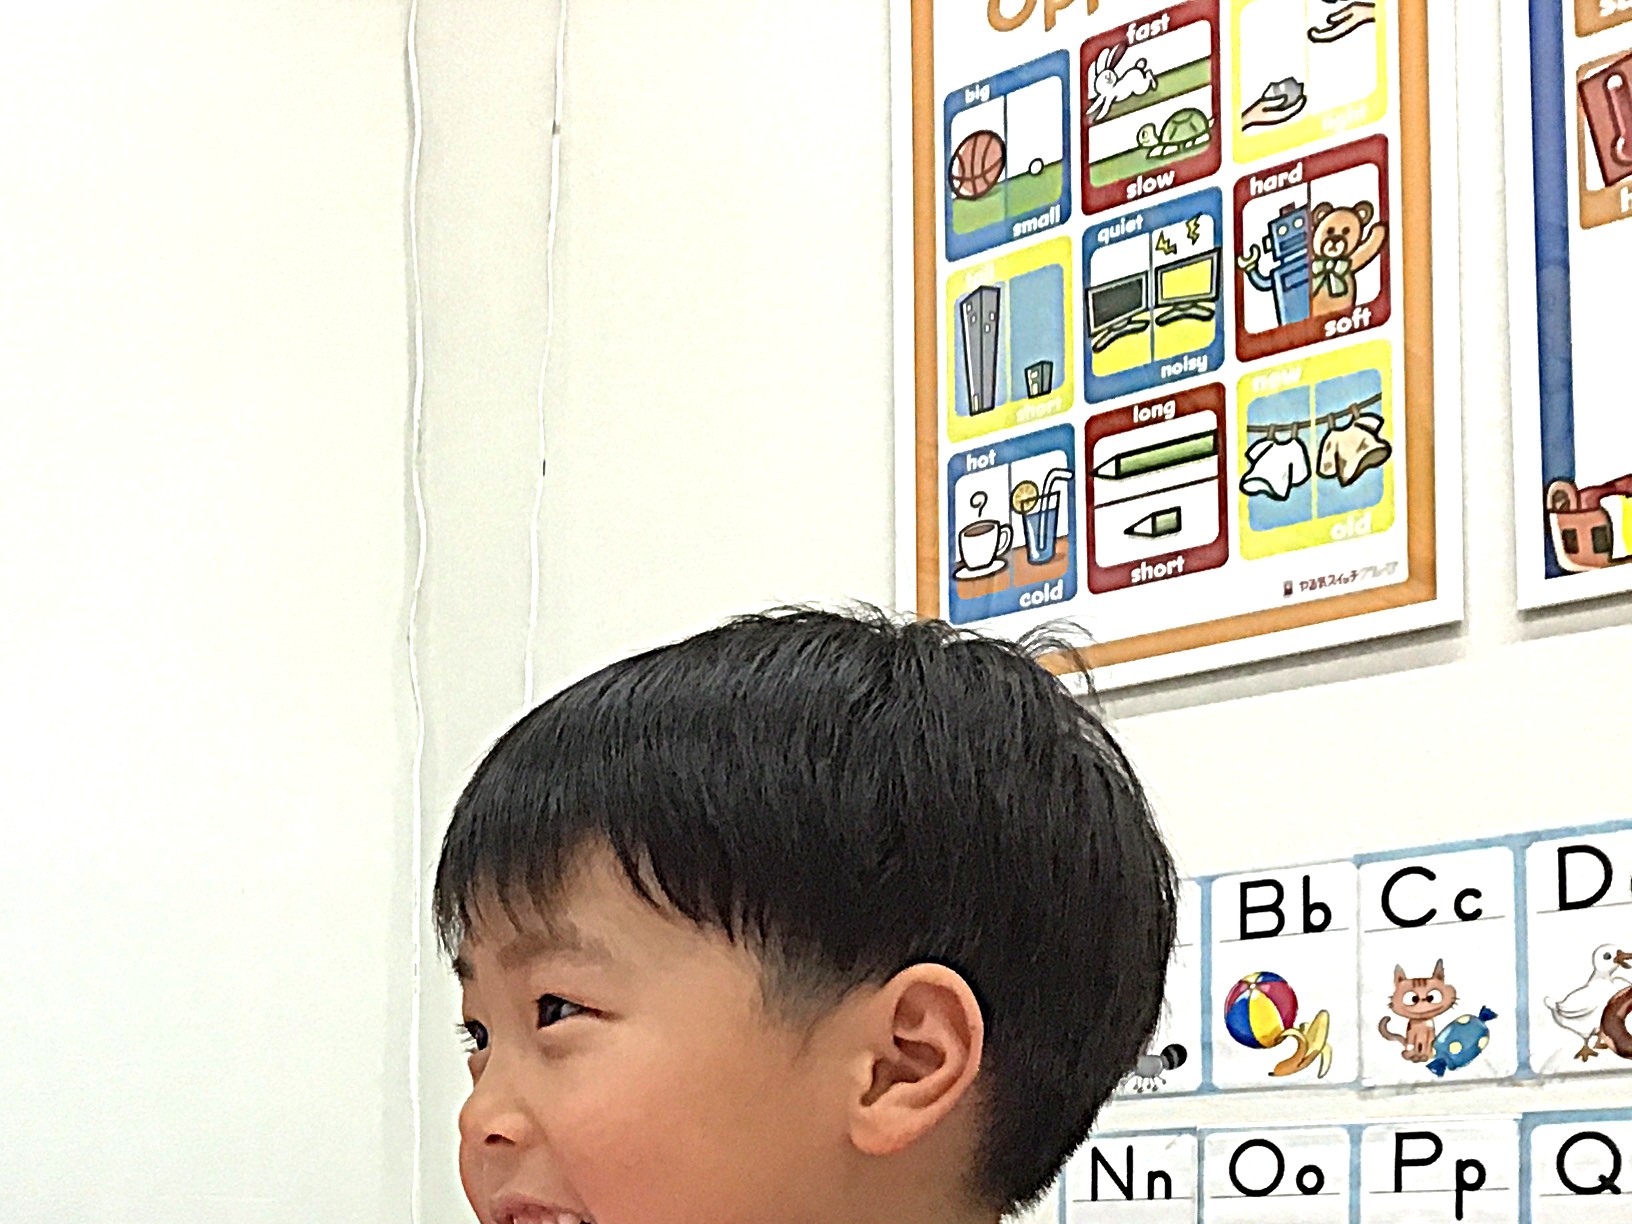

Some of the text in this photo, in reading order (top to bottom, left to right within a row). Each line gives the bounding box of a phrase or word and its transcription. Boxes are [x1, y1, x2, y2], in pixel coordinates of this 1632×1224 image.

[1126, 13, 1170, 45] fast
[965, 84, 991, 104] big
[1126, 171, 1176, 199] slow
[1249, 161, 1303, 196] hard
[1012, 204, 1061, 237] small
[1097, 214, 1144, 244] quiet
[1323, 307, 1372, 338] soft
[1160, 353, 1208, 379] noisy
[1251, 366, 1303, 393] new
[1132, 400, 1176, 423] long
[966, 449, 997, 472] hot
[1330, 510, 1372, 540] old
[1131, 555, 1185, 584] short
[1019, 579, 1064, 608] cold
[1556, 844, 1632, 912] D
[1239, 874, 1332, 941] Bb
[1381, 866, 1484, 929] Cc
[1090, 1144, 1172, 1201] Nn
[1229, 1138, 1325, 1197] Oo
[1394, 1130, 1487, 1220] Pp
